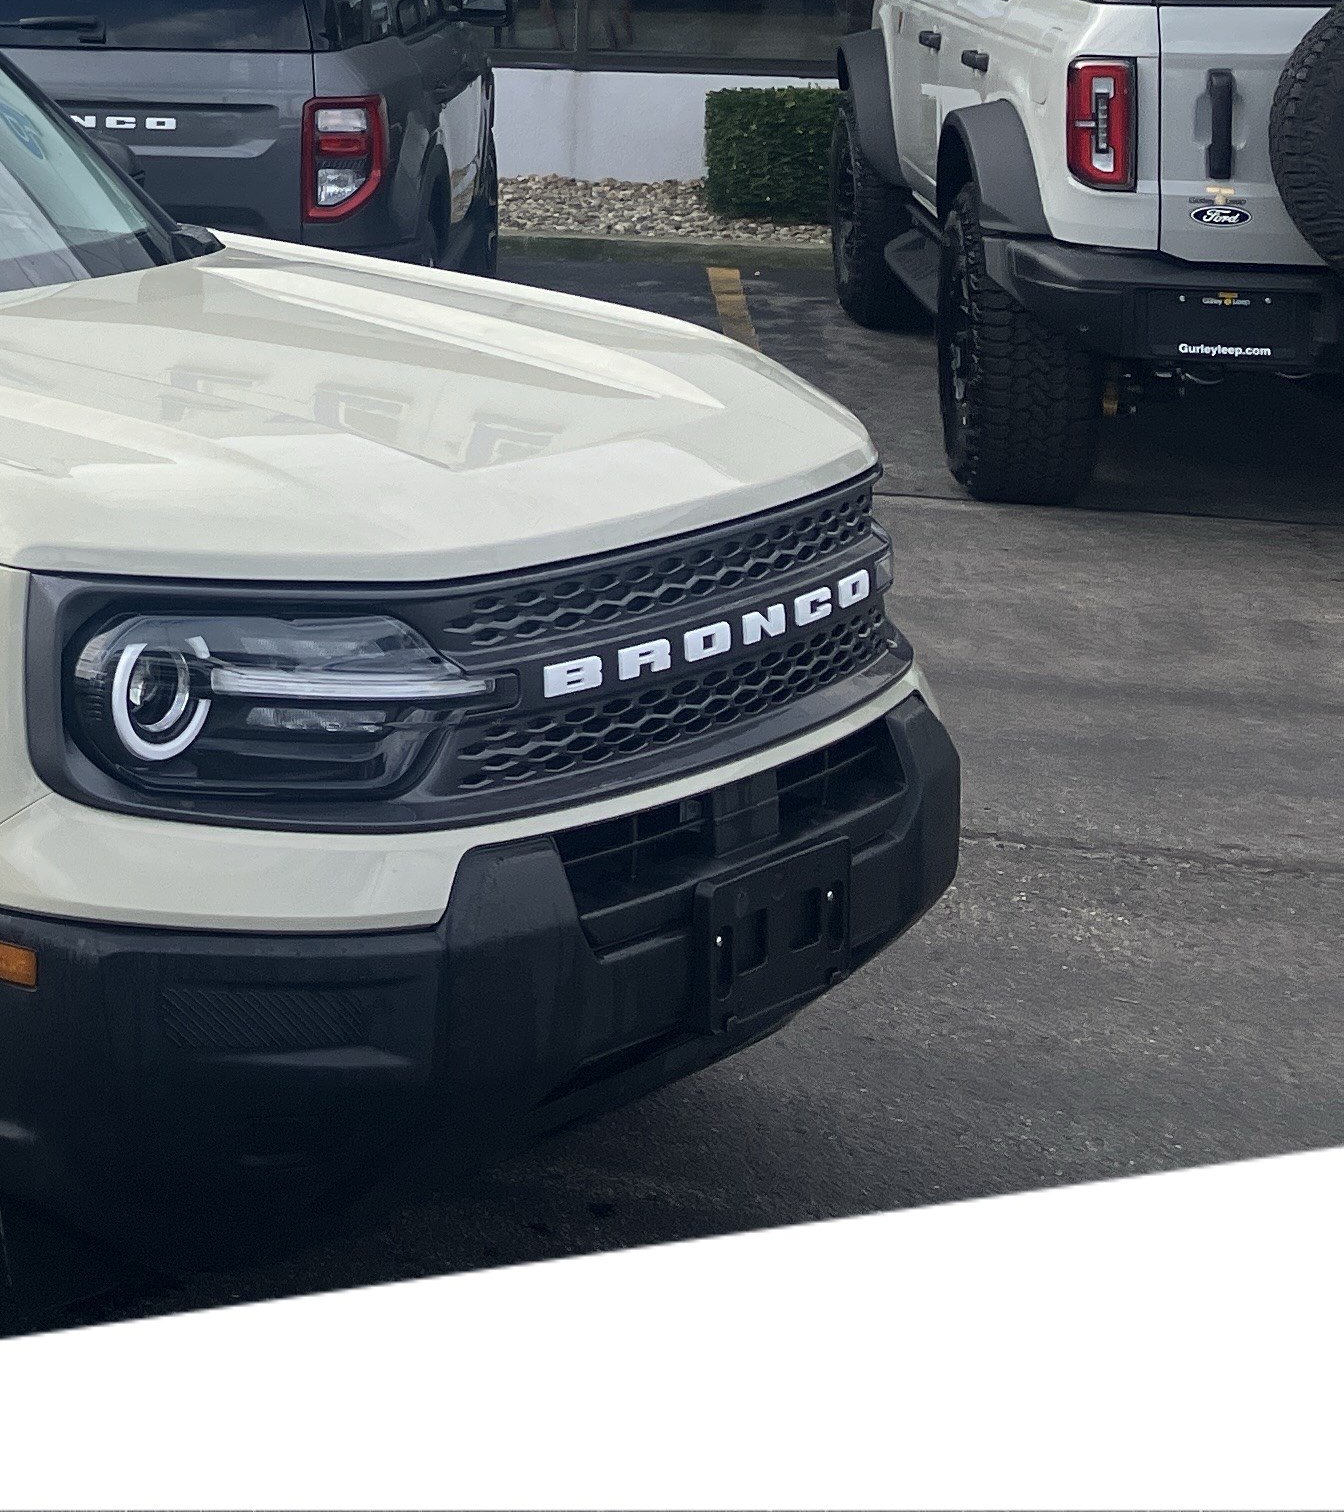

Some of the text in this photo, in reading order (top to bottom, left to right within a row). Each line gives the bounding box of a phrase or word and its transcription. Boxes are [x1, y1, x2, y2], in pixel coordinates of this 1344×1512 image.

[70, 115, 177, 130] NCO
[1202, 208, 1241, 224] Ford
[1178, 343, 1272, 357] Gurleyleep.com
[543, 568, 870, 698] BRONCO
